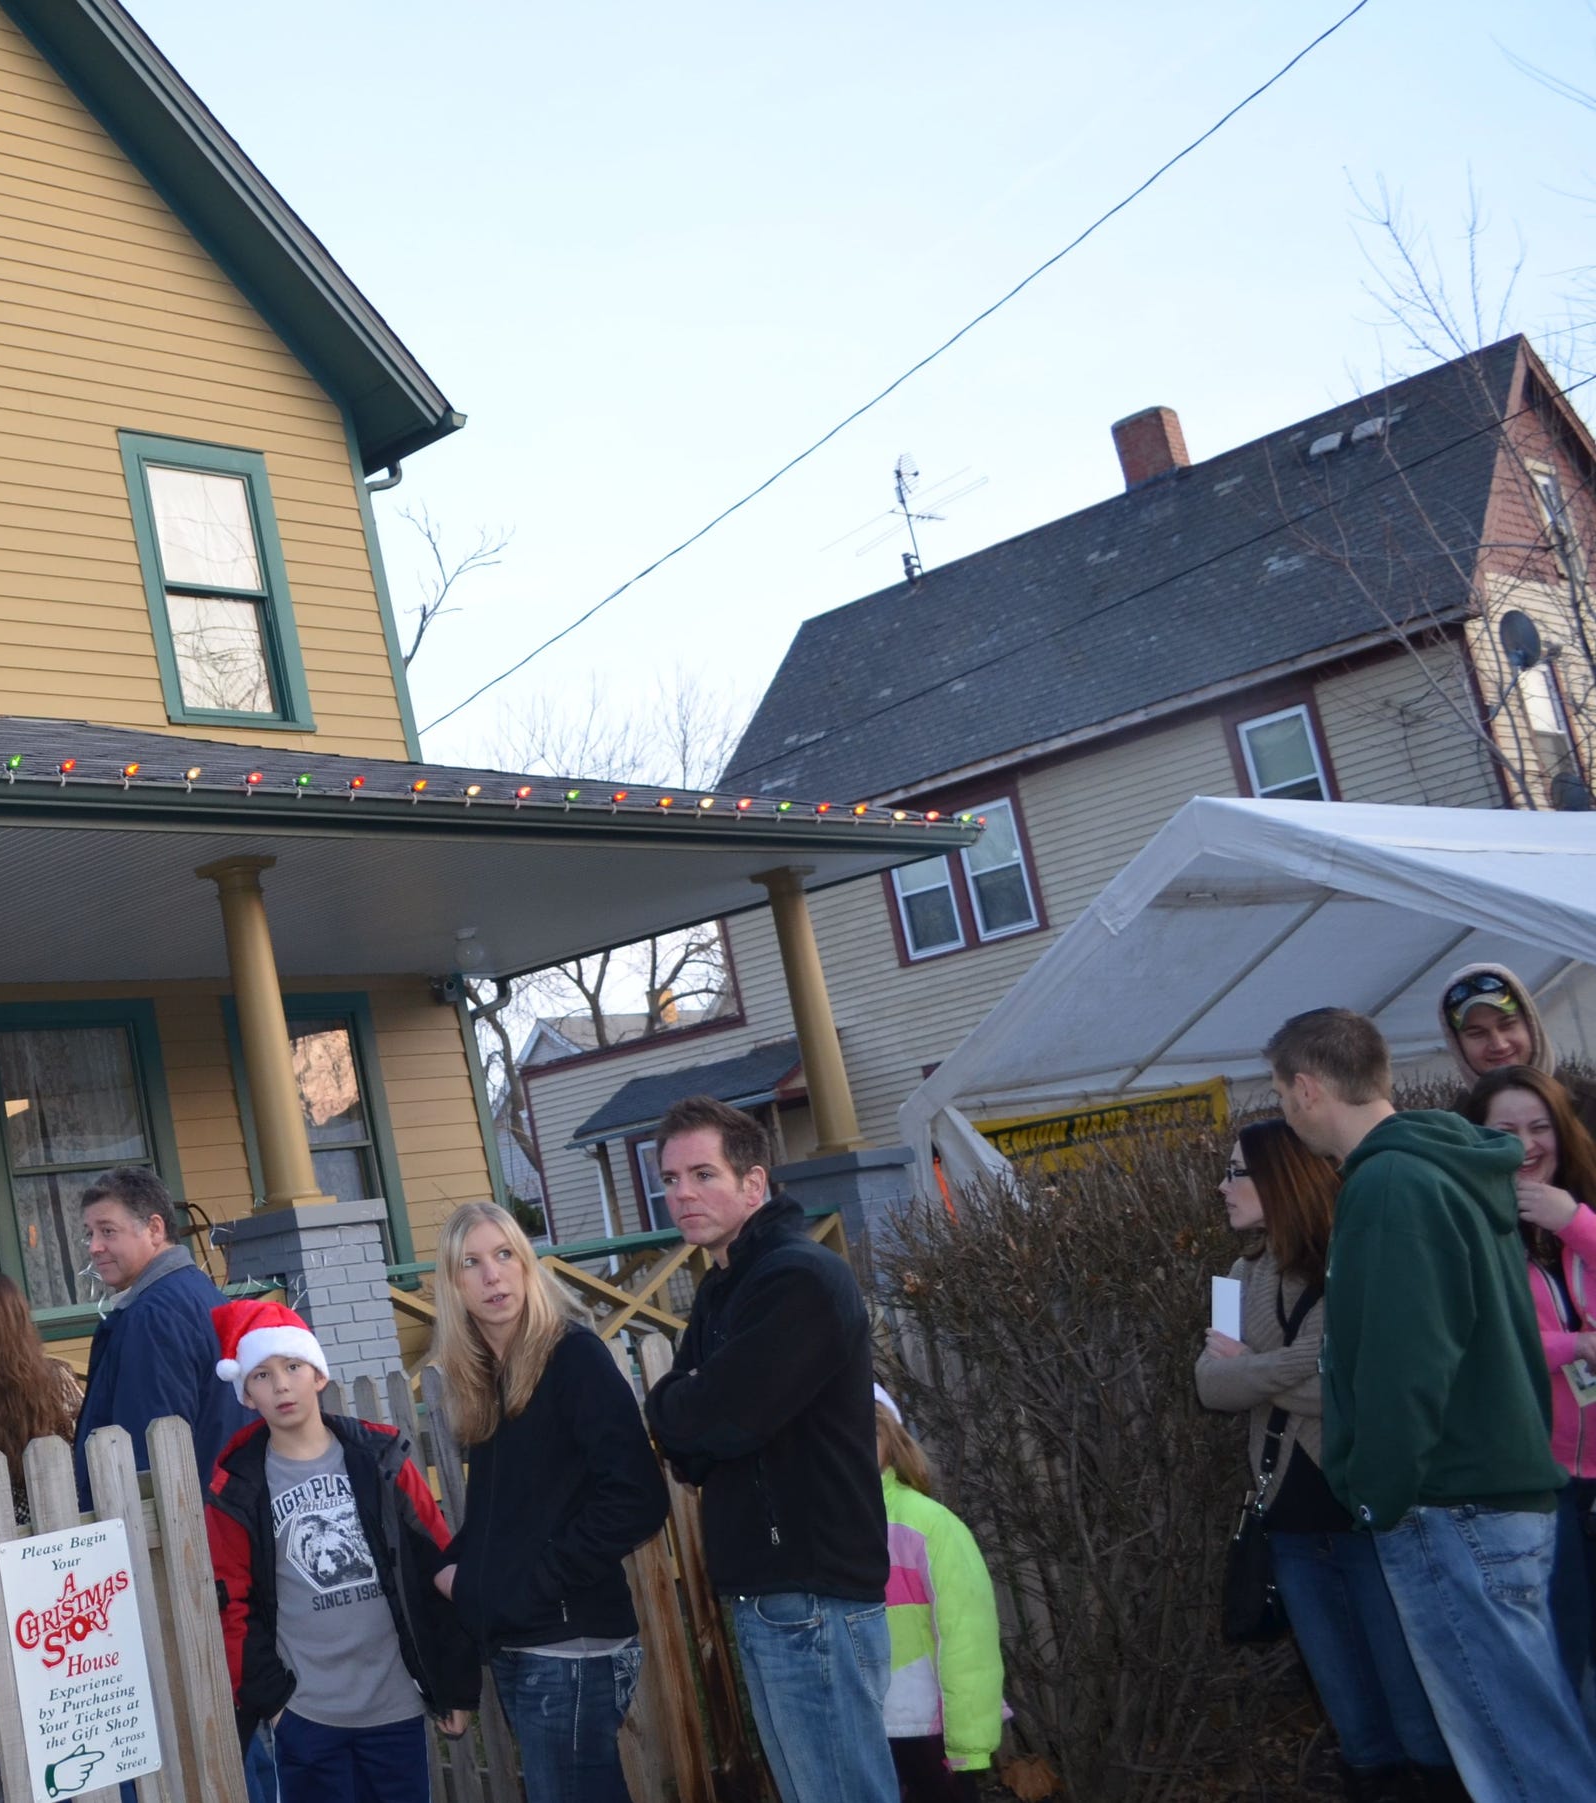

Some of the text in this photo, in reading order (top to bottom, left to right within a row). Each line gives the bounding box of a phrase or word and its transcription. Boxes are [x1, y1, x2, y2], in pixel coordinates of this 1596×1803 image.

[271, 1476, 354, 1532] HIGH PLA
[21, 1532, 106, 1560] Please Begin
[52, 1557, 81, 1571] Your
[57, 1572, 76, 1602] A
[312, 1588, 352, 1611] SINCE
[15, 1571, 129, 1650] CHRISTMAS
[41, 1598, 112, 1669] STORY
[66, 1651, 119, 1678] House
[49, 1674, 123, 1701] Experience
[39, 1686, 136, 1721] by Purchasing
[39, 1699, 140, 1736] Your Tickets at
[46, 1716, 139, 1750] the Gift Shop
[110, 1731, 146, 1748] Across
[115, 1757, 147, 1773] Street
[121, 1746, 138, 1758] the
